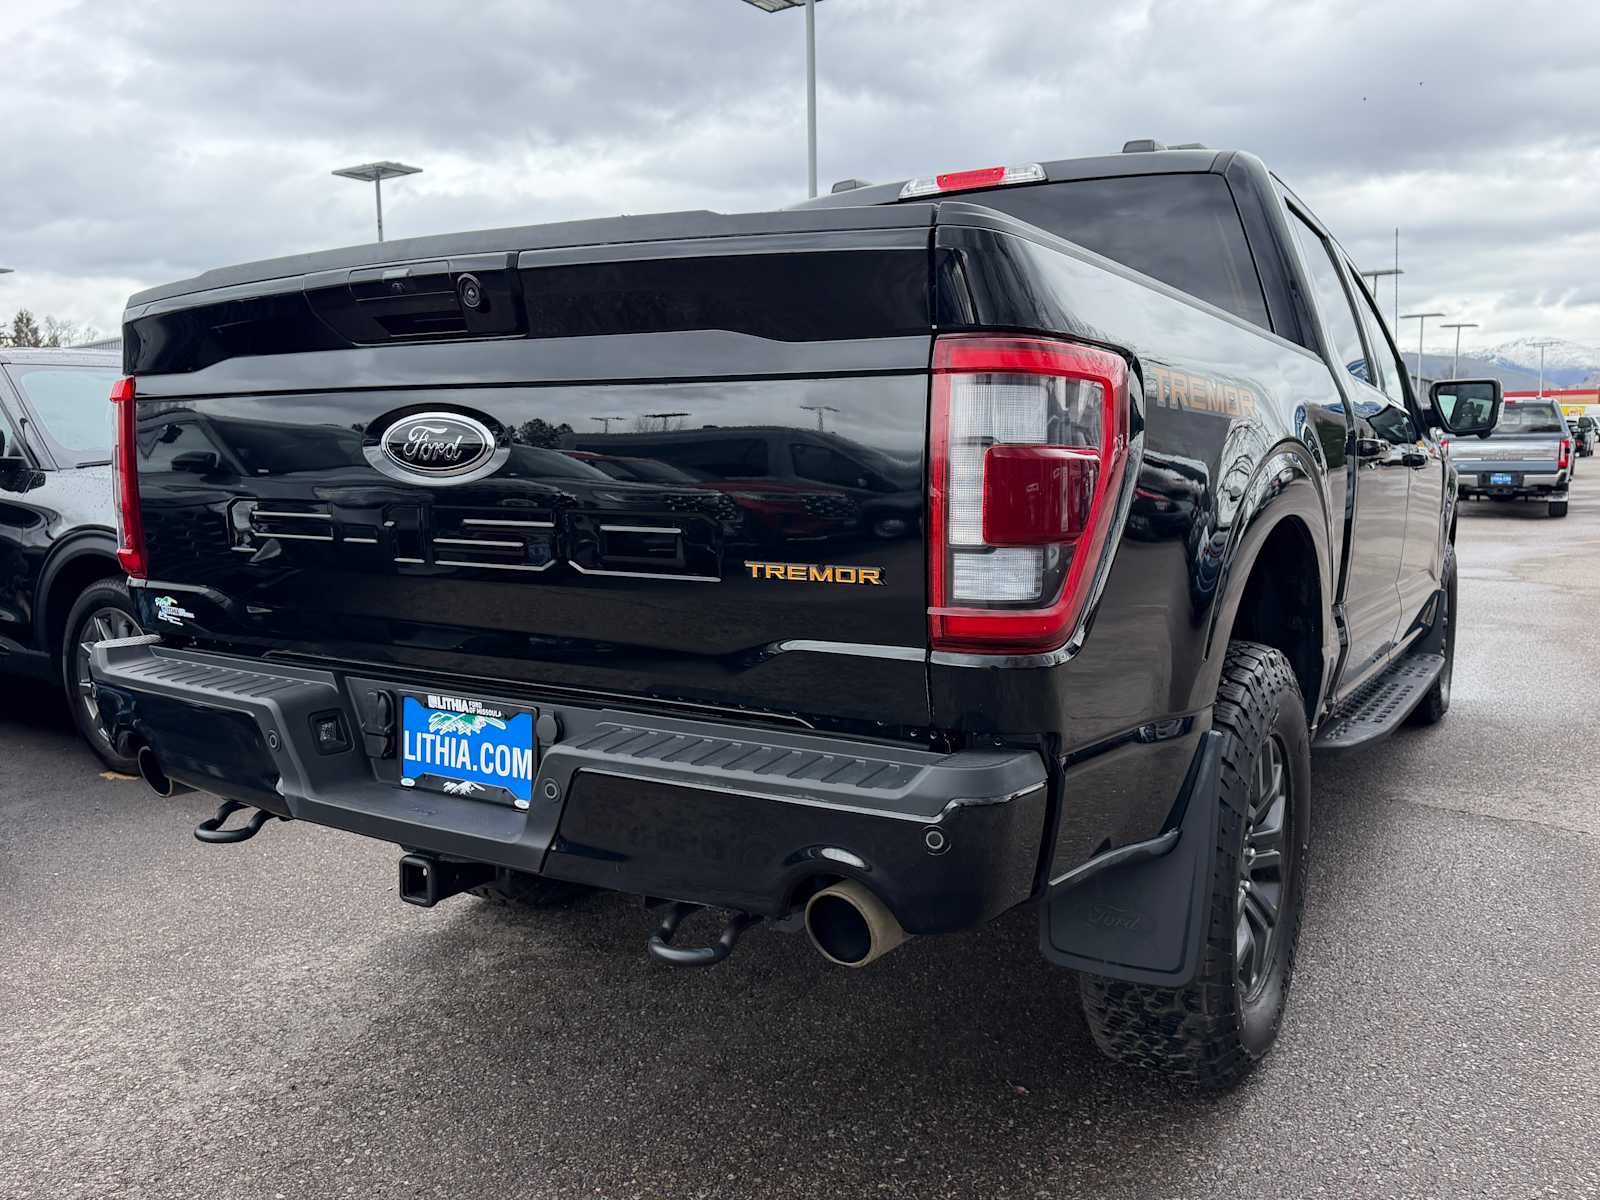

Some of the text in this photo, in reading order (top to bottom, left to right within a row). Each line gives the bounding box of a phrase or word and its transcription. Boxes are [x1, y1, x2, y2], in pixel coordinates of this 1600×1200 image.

[1151, 366, 1257, 418] TREMOR
[403, 425, 464, 461] Ford
[744, 560, 886, 586] TREMOR
[437, 696, 469, 713] LITHIA
[404, 730, 532, 780] LITHIA.COM
[1086, 903, 1145, 930] Ford
